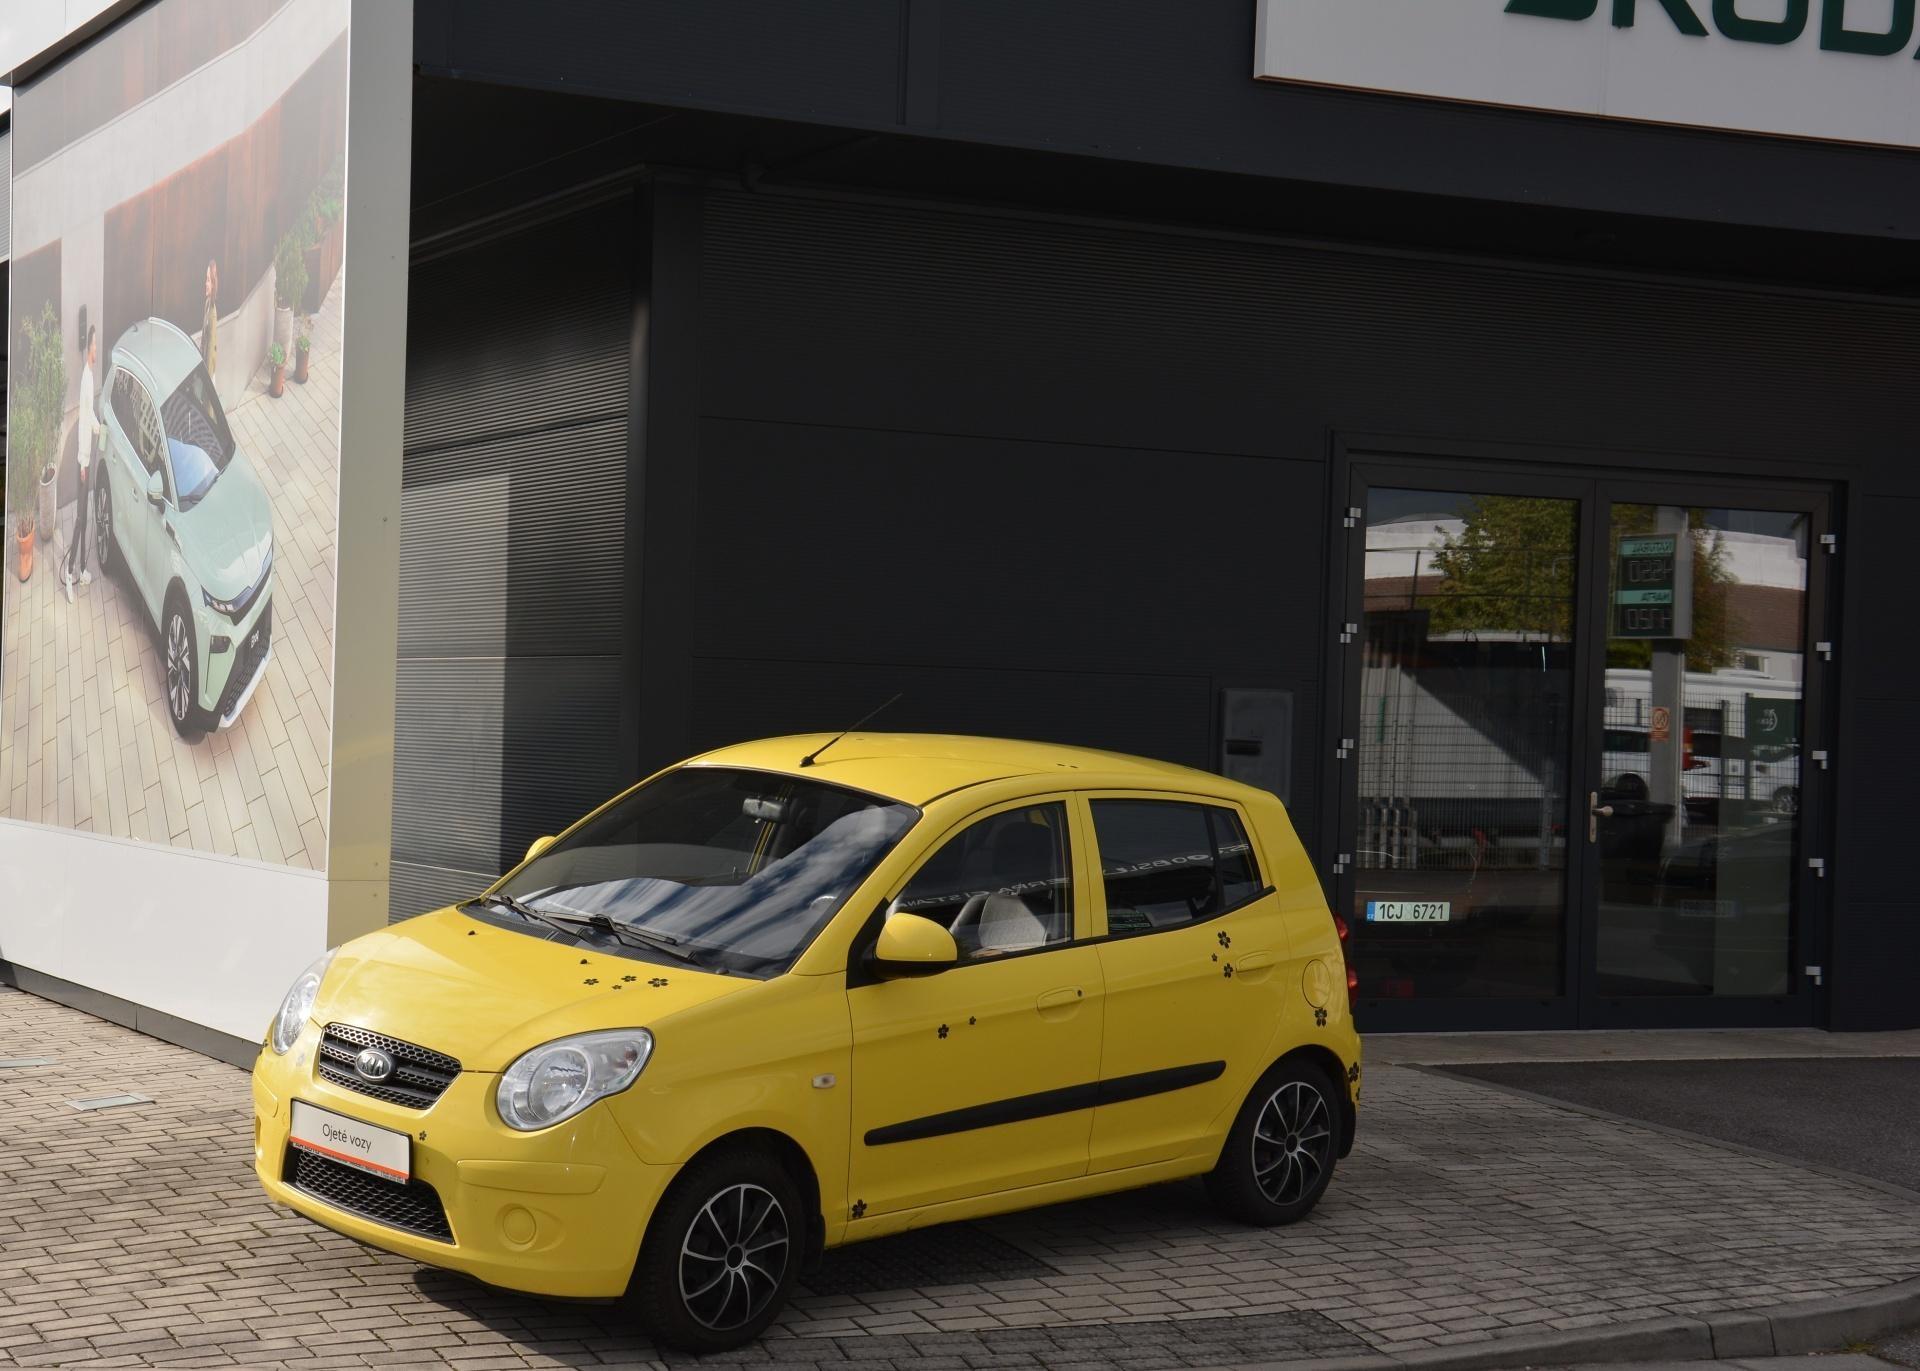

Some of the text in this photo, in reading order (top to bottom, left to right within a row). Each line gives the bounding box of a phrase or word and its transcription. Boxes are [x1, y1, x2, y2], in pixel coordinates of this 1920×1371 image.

[1379, 903, 1403, 919] 1CJ
[1412, 903, 1443, 919] 6721
[360, 1052, 386, 1076] KIA
[322, 1123, 372, 1154] Ojeté vozy
